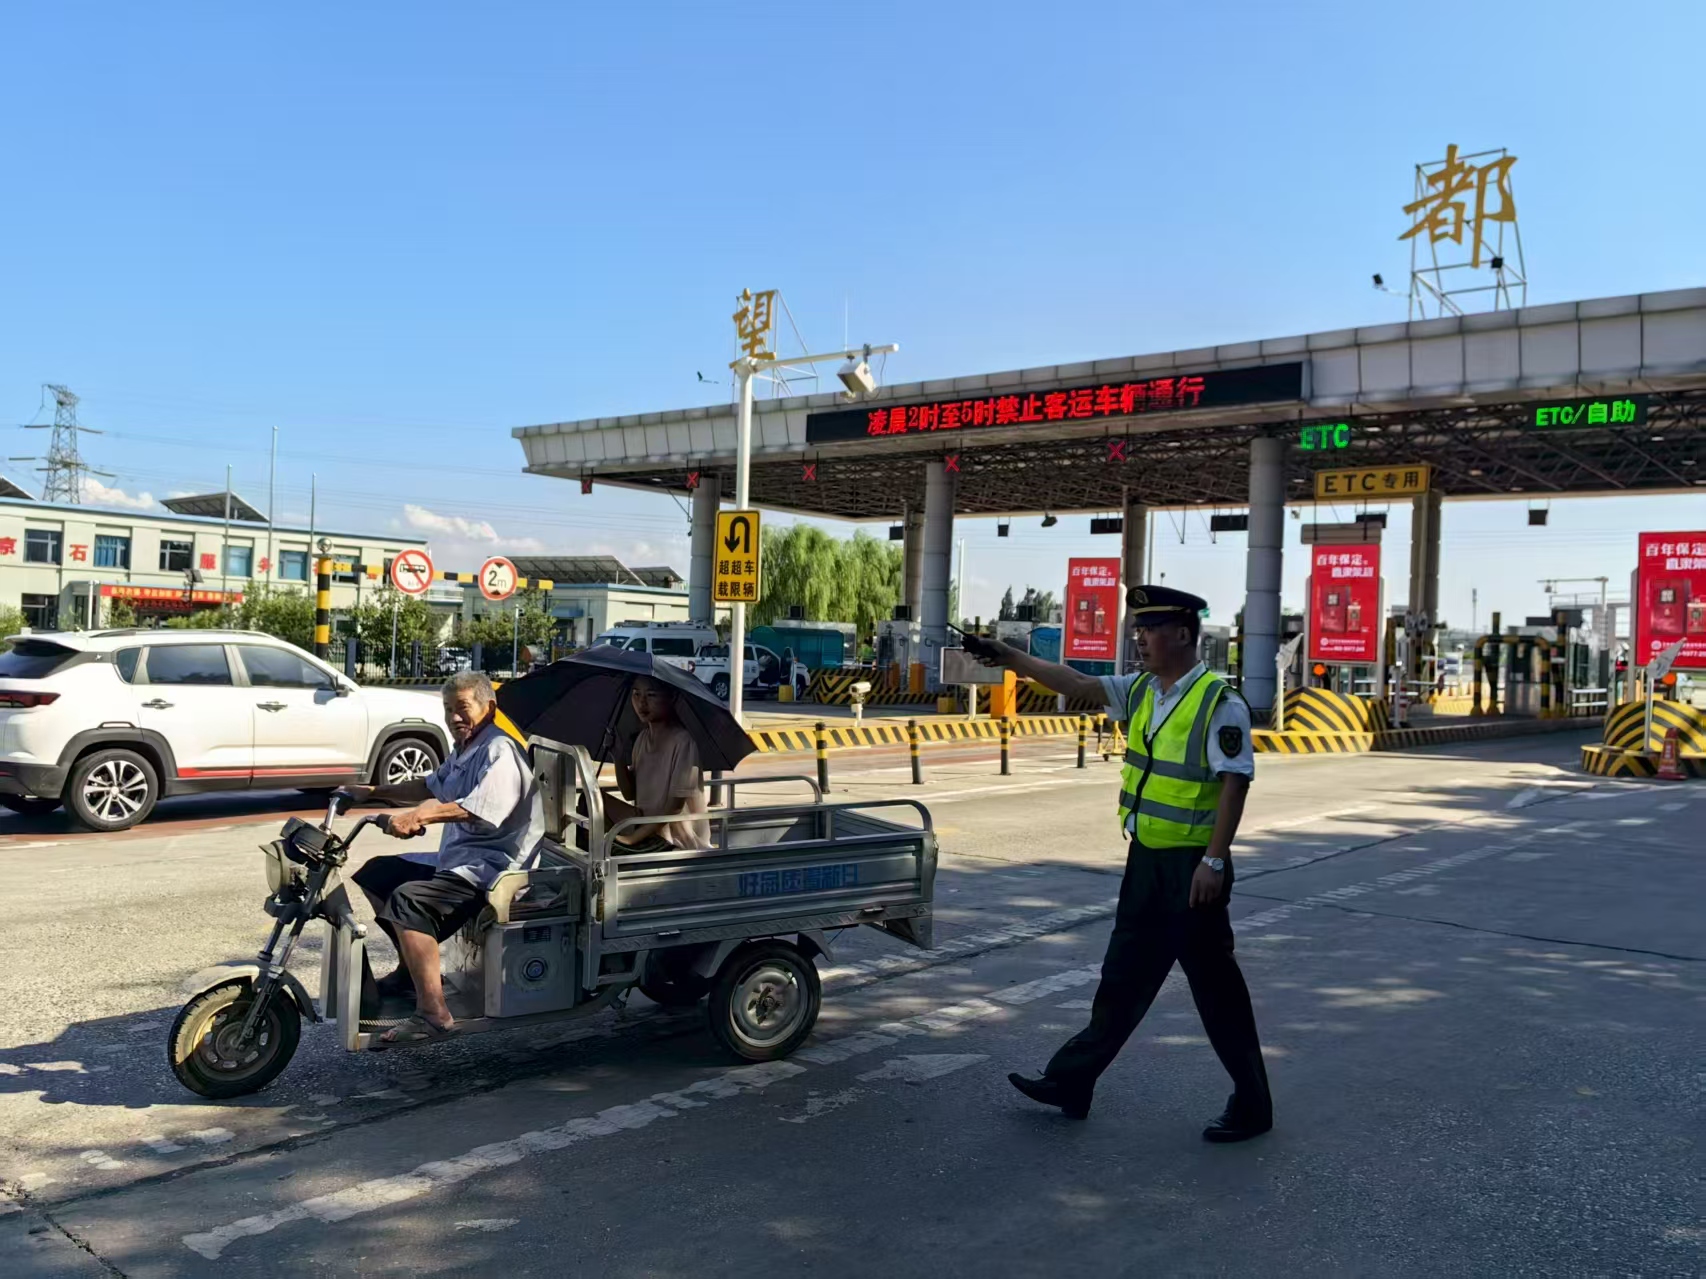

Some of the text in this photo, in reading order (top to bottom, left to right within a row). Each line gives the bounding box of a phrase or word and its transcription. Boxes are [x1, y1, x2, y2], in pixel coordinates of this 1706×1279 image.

[1398, 143, 1518, 268] 都
[729, 287, 778, 369] 望
[866, 376, 1205, 437] 凌晨2时至5时禁止客运车辆通行
[1536, 399, 1636, 426] ETC/自助
[1301, 423, 1349, 450] ETC
[1324, 471, 1419, 494] ETC专用
